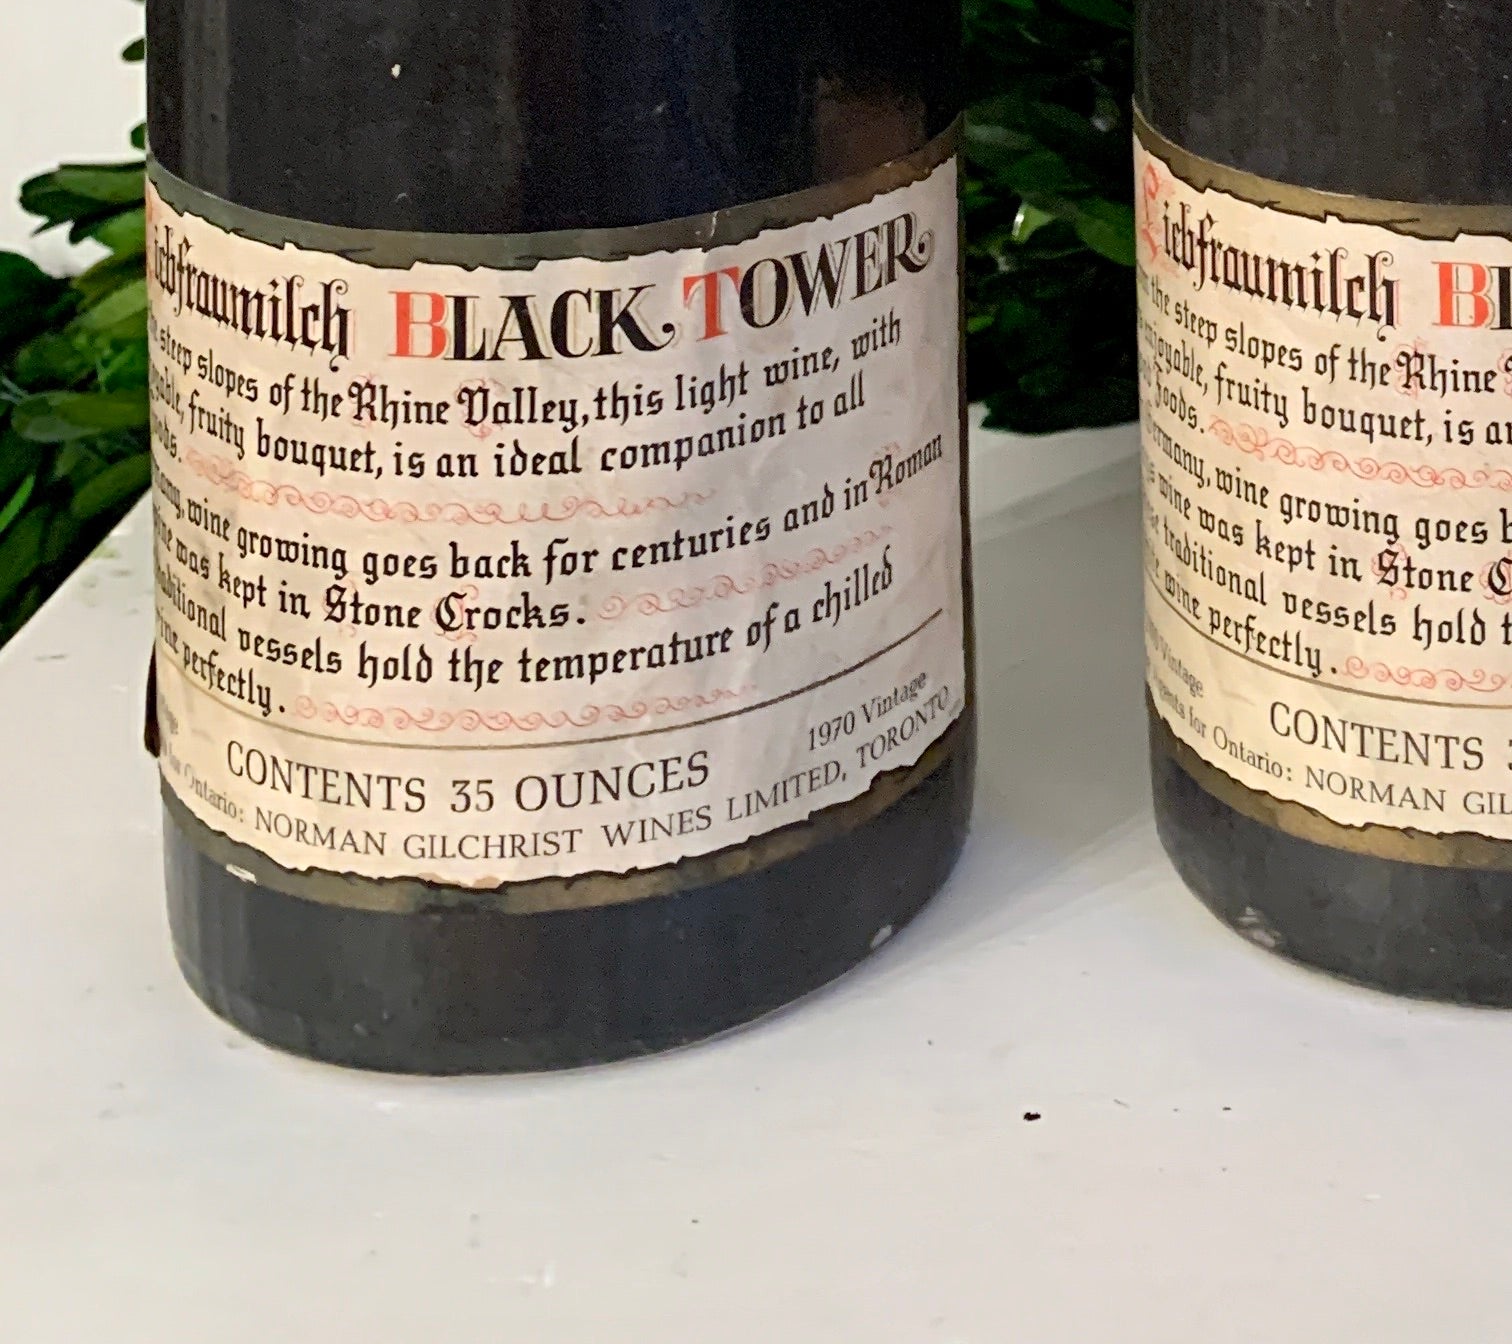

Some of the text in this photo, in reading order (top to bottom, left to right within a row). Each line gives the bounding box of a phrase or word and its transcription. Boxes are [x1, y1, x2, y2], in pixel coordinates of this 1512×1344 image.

[1214, 362, 1289, 429] fruity
[1302, 386, 1432, 445] bouquet,
[1443, 409, 1474, 445] is
[543, 538, 600, 585] for
[1158, 471, 1191, 520] wine
[1198, 504, 1244, 546] was
[1255, 519, 1315, 572] kept
[1329, 545, 1362, 581] in
[1376, 549, 1474, 593] Stone
[238, 544, 894, 692] vessels hold the temperature of a chilled
[1209, 606, 1337, 677] perfectly.
[183, 641, 285, 717] perfectly.
[807, 672, 927, 751] 1970 Vintage
[254, 685, 950, 860] NORMAN GILCHRIST WINES LIMITED, TORONTO
[1213, 726, 1292, 781] Ontario:
[1305, 766, 1446, 812] NORMAN
[1270, 700, 1484, 772] CONTENTS
[227, 740, 426, 813] CONTENTS
[450, 779, 494, 813] 35
[515, 750, 710, 812] OUNCES
